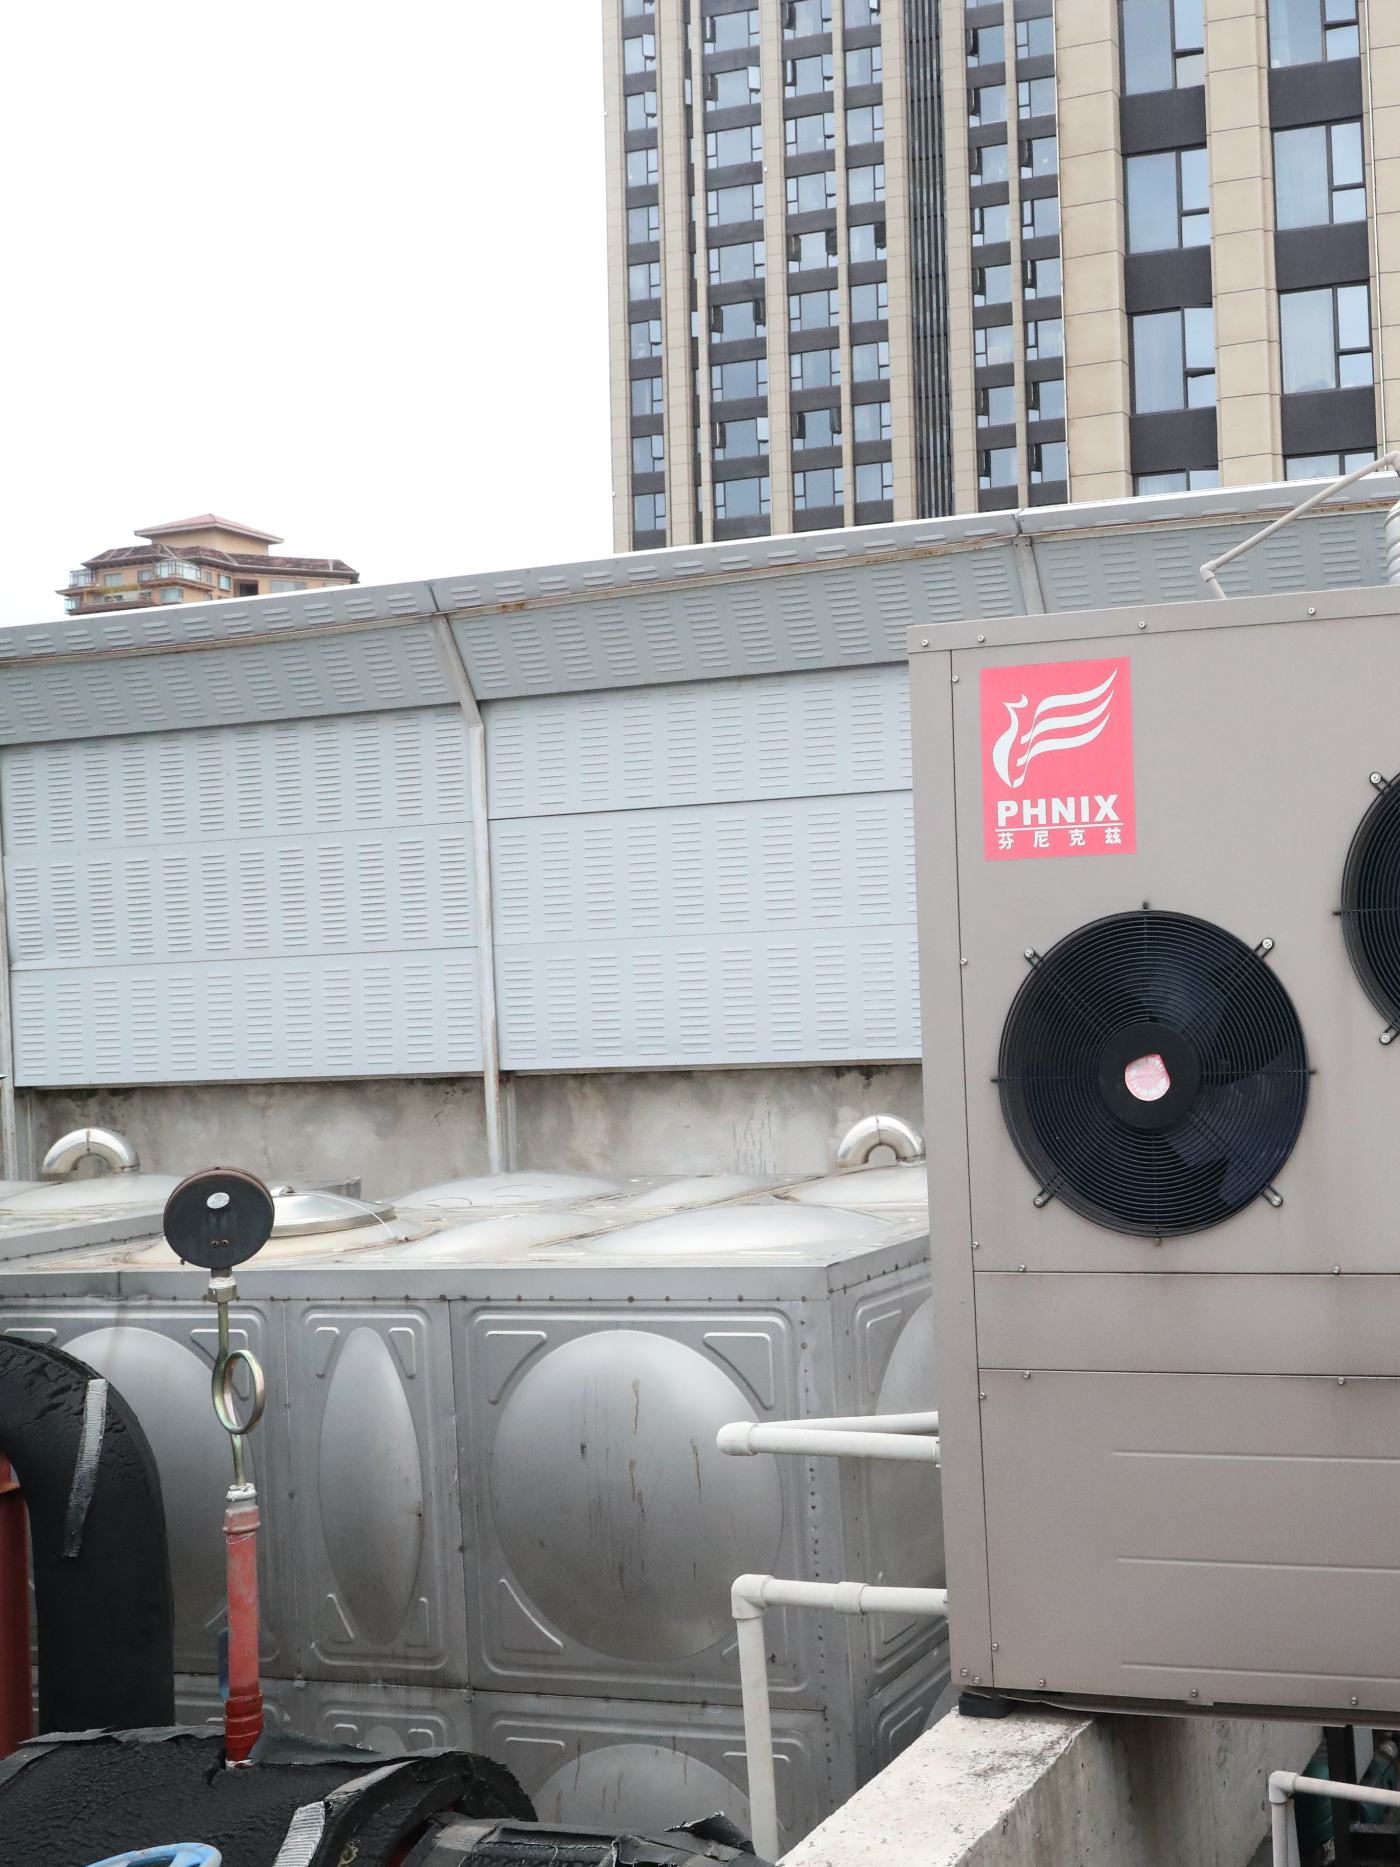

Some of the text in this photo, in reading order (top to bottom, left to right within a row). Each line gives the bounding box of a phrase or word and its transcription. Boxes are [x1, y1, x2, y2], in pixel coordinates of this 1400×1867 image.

[997, 794, 1120, 827] PHNIX
[998, 827, 1122, 850] 芬尼克兹
